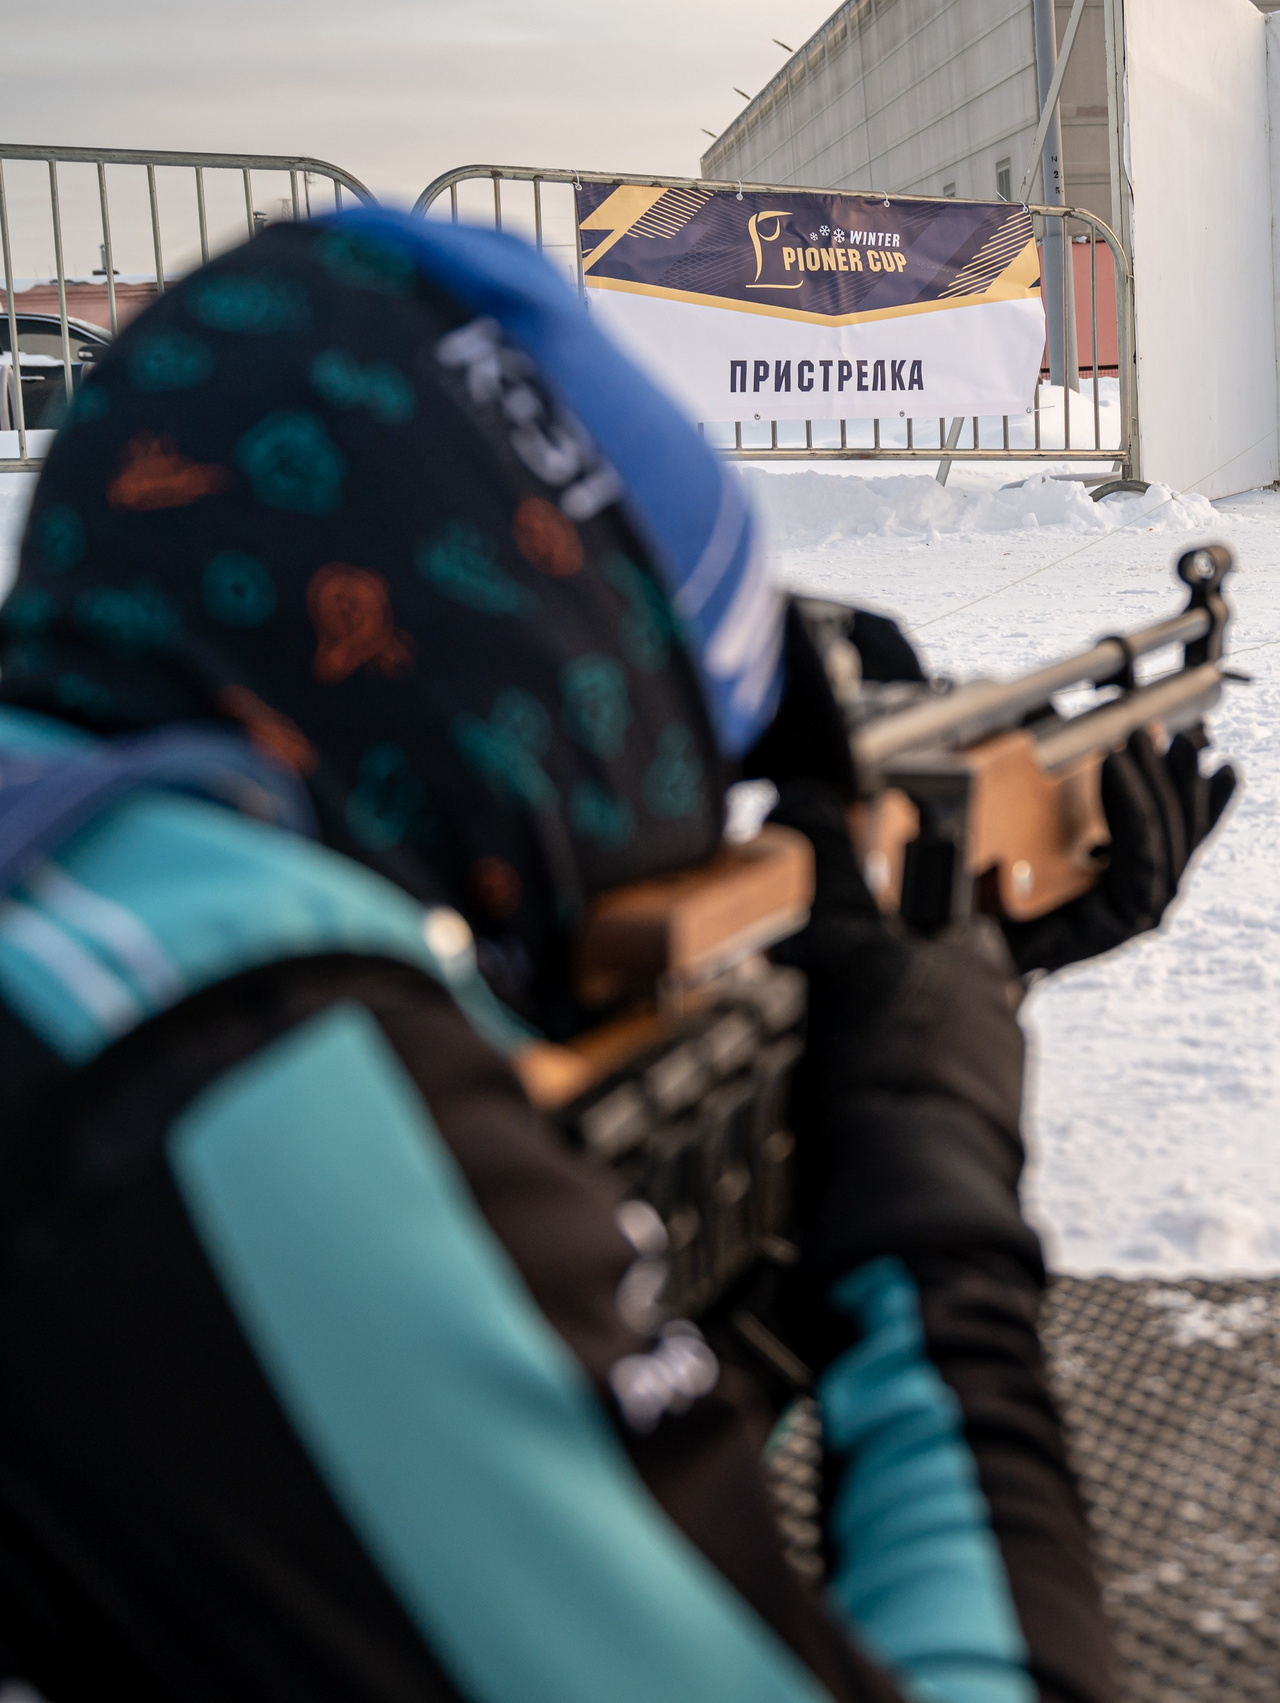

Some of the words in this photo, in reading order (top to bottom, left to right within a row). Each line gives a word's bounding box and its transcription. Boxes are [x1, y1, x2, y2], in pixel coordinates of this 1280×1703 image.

[849, 229, 901, 248] WINTER
[782, 246, 863, 272] PIONER
[866, 249, 907, 273] CUP
[730, 359, 924, 393] ПРИСТРЕЛКА
